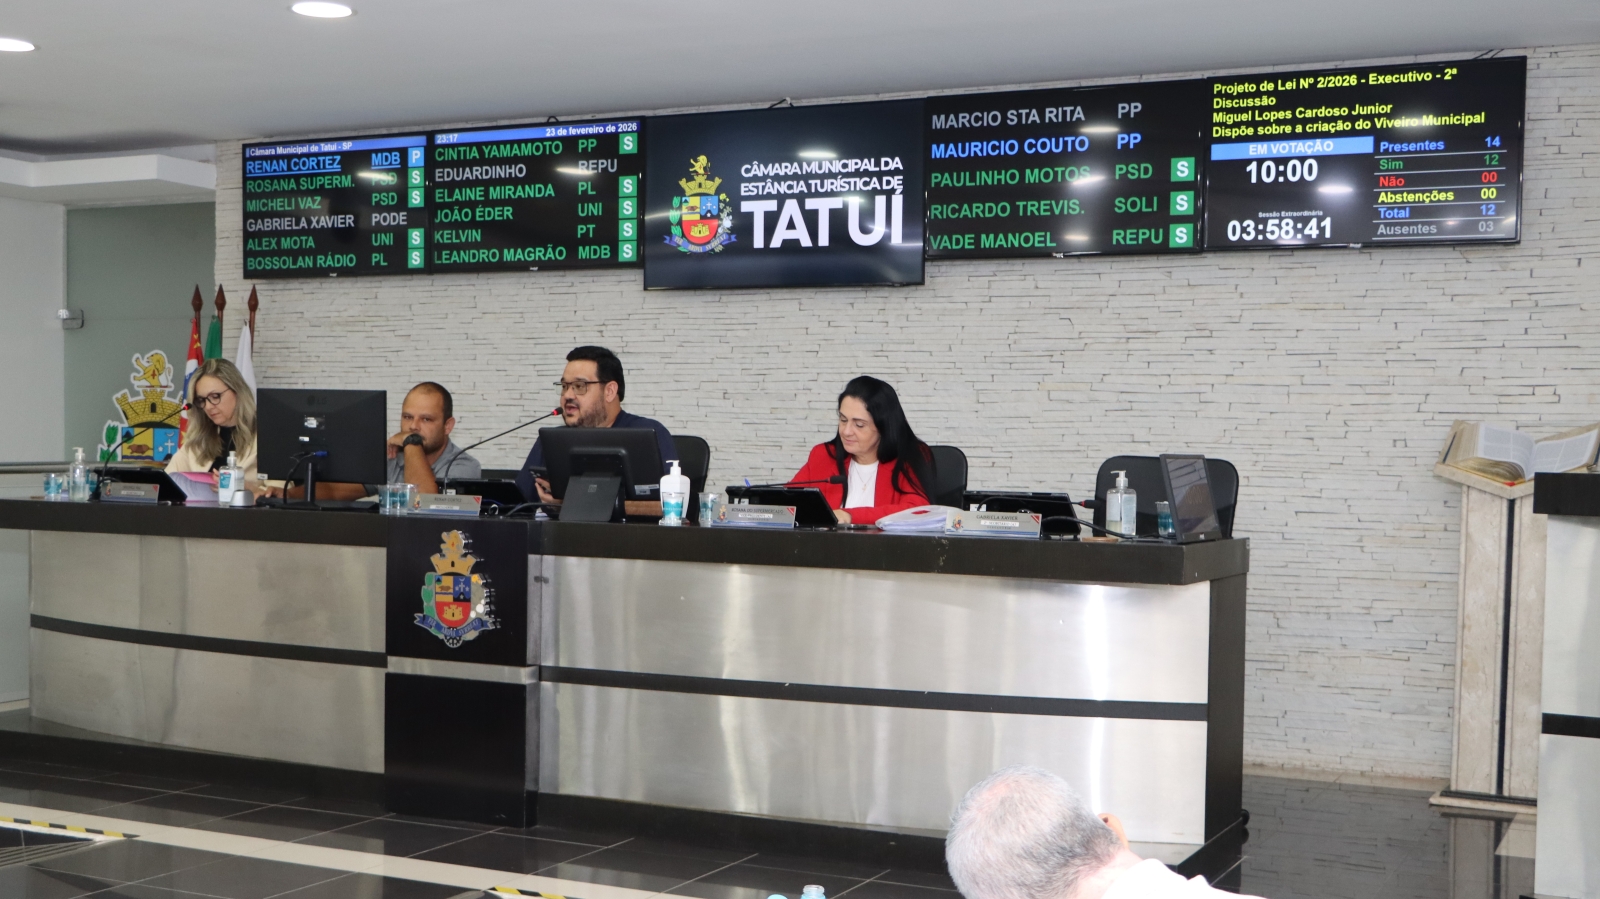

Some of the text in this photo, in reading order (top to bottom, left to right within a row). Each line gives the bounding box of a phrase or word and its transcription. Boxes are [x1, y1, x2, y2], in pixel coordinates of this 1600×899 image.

[1214, 83, 1256, 95] Projeto
[1260, 80, 1275, 91] de
[1278, 79, 1296, 90] Lei
[1317, 76, 1357, 88] 2/2026
[1369, 72, 1432, 84] Executivo
[1213, 95, 1276, 108] Discussão
[932, 103, 1142, 130] MARCIO STA RITA PP
[1213, 103, 1392, 125] Miguel Lopes Cardoso Junior
[437, 123, 637, 143] 23:17 23 de fevereiro de 2026
[1212, 112, 1485, 138] Dispõe sobre a criação do Viveiro Municipal
[250, 147, 275, 156] Câmara
[277, 144, 308, 154] Municipal
[310, 144, 318, 152] de
[436, 136, 633, 161] CINTIA YAMAMOTO PP S
[931, 133, 1141, 158] MAURICIO COUTO PP
[1249, 140, 1334, 155] EM VOTAÇÃO
[1380, 136, 1500, 152] Presentes 14
[246, 151, 420, 174] RENAN CORTEZ MDB P
[436, 159, 617, 181] EDUARDINHO REPU
[741, 157, 903, 177] CÂMARA MUNICIPAL DA
[1246, 158, 1318, 184] 10:00
[1380, 154, 1499, 170] Sim 12
[247, 171, 420, 192] ROSANA SUPERM. PSD S
[931, 161, 1188, 188] PAULINHO MOTOS PSD S
[1380, 172, 1497, 187] Não 00
[436, 179, 632, 202] ELAINE MIRANDA PL S
[741, 176, 903, 196] ESTÂNCIA TURÍSTICA DE
[1378, 188, 1496, 203] Abstenções 00
[247, 191, 420, 212] MICHELI VAZ PSD S
[435, 201, 632, 223] JOÃO ÉDER UNI S
[931, 195, 1188, 219] RICARDO TREVIS. SOLI S
[1378, 204, 1495, 219] Total 12
[247, 212, 407, 231] GABRIELA XAVIER PODE
[741, 188, 903, 248] TATUÍ
[1377, 221, 1494, 235] Ausentes 03
[435, 223, 632, 244] KELVIN PT S
[930, 227, 1187, 250] VADE MANOEL REPU S
[1227, 216, 1332, 242] 03:58:41
[247, 231, 420, 250] ALEX MOTA UNI S
[247, 251, 420, 270] BOSSOLAN RÁDIO PL S
[434, 244, 632, 264] LEANDRO MAGRÃO MDB S
